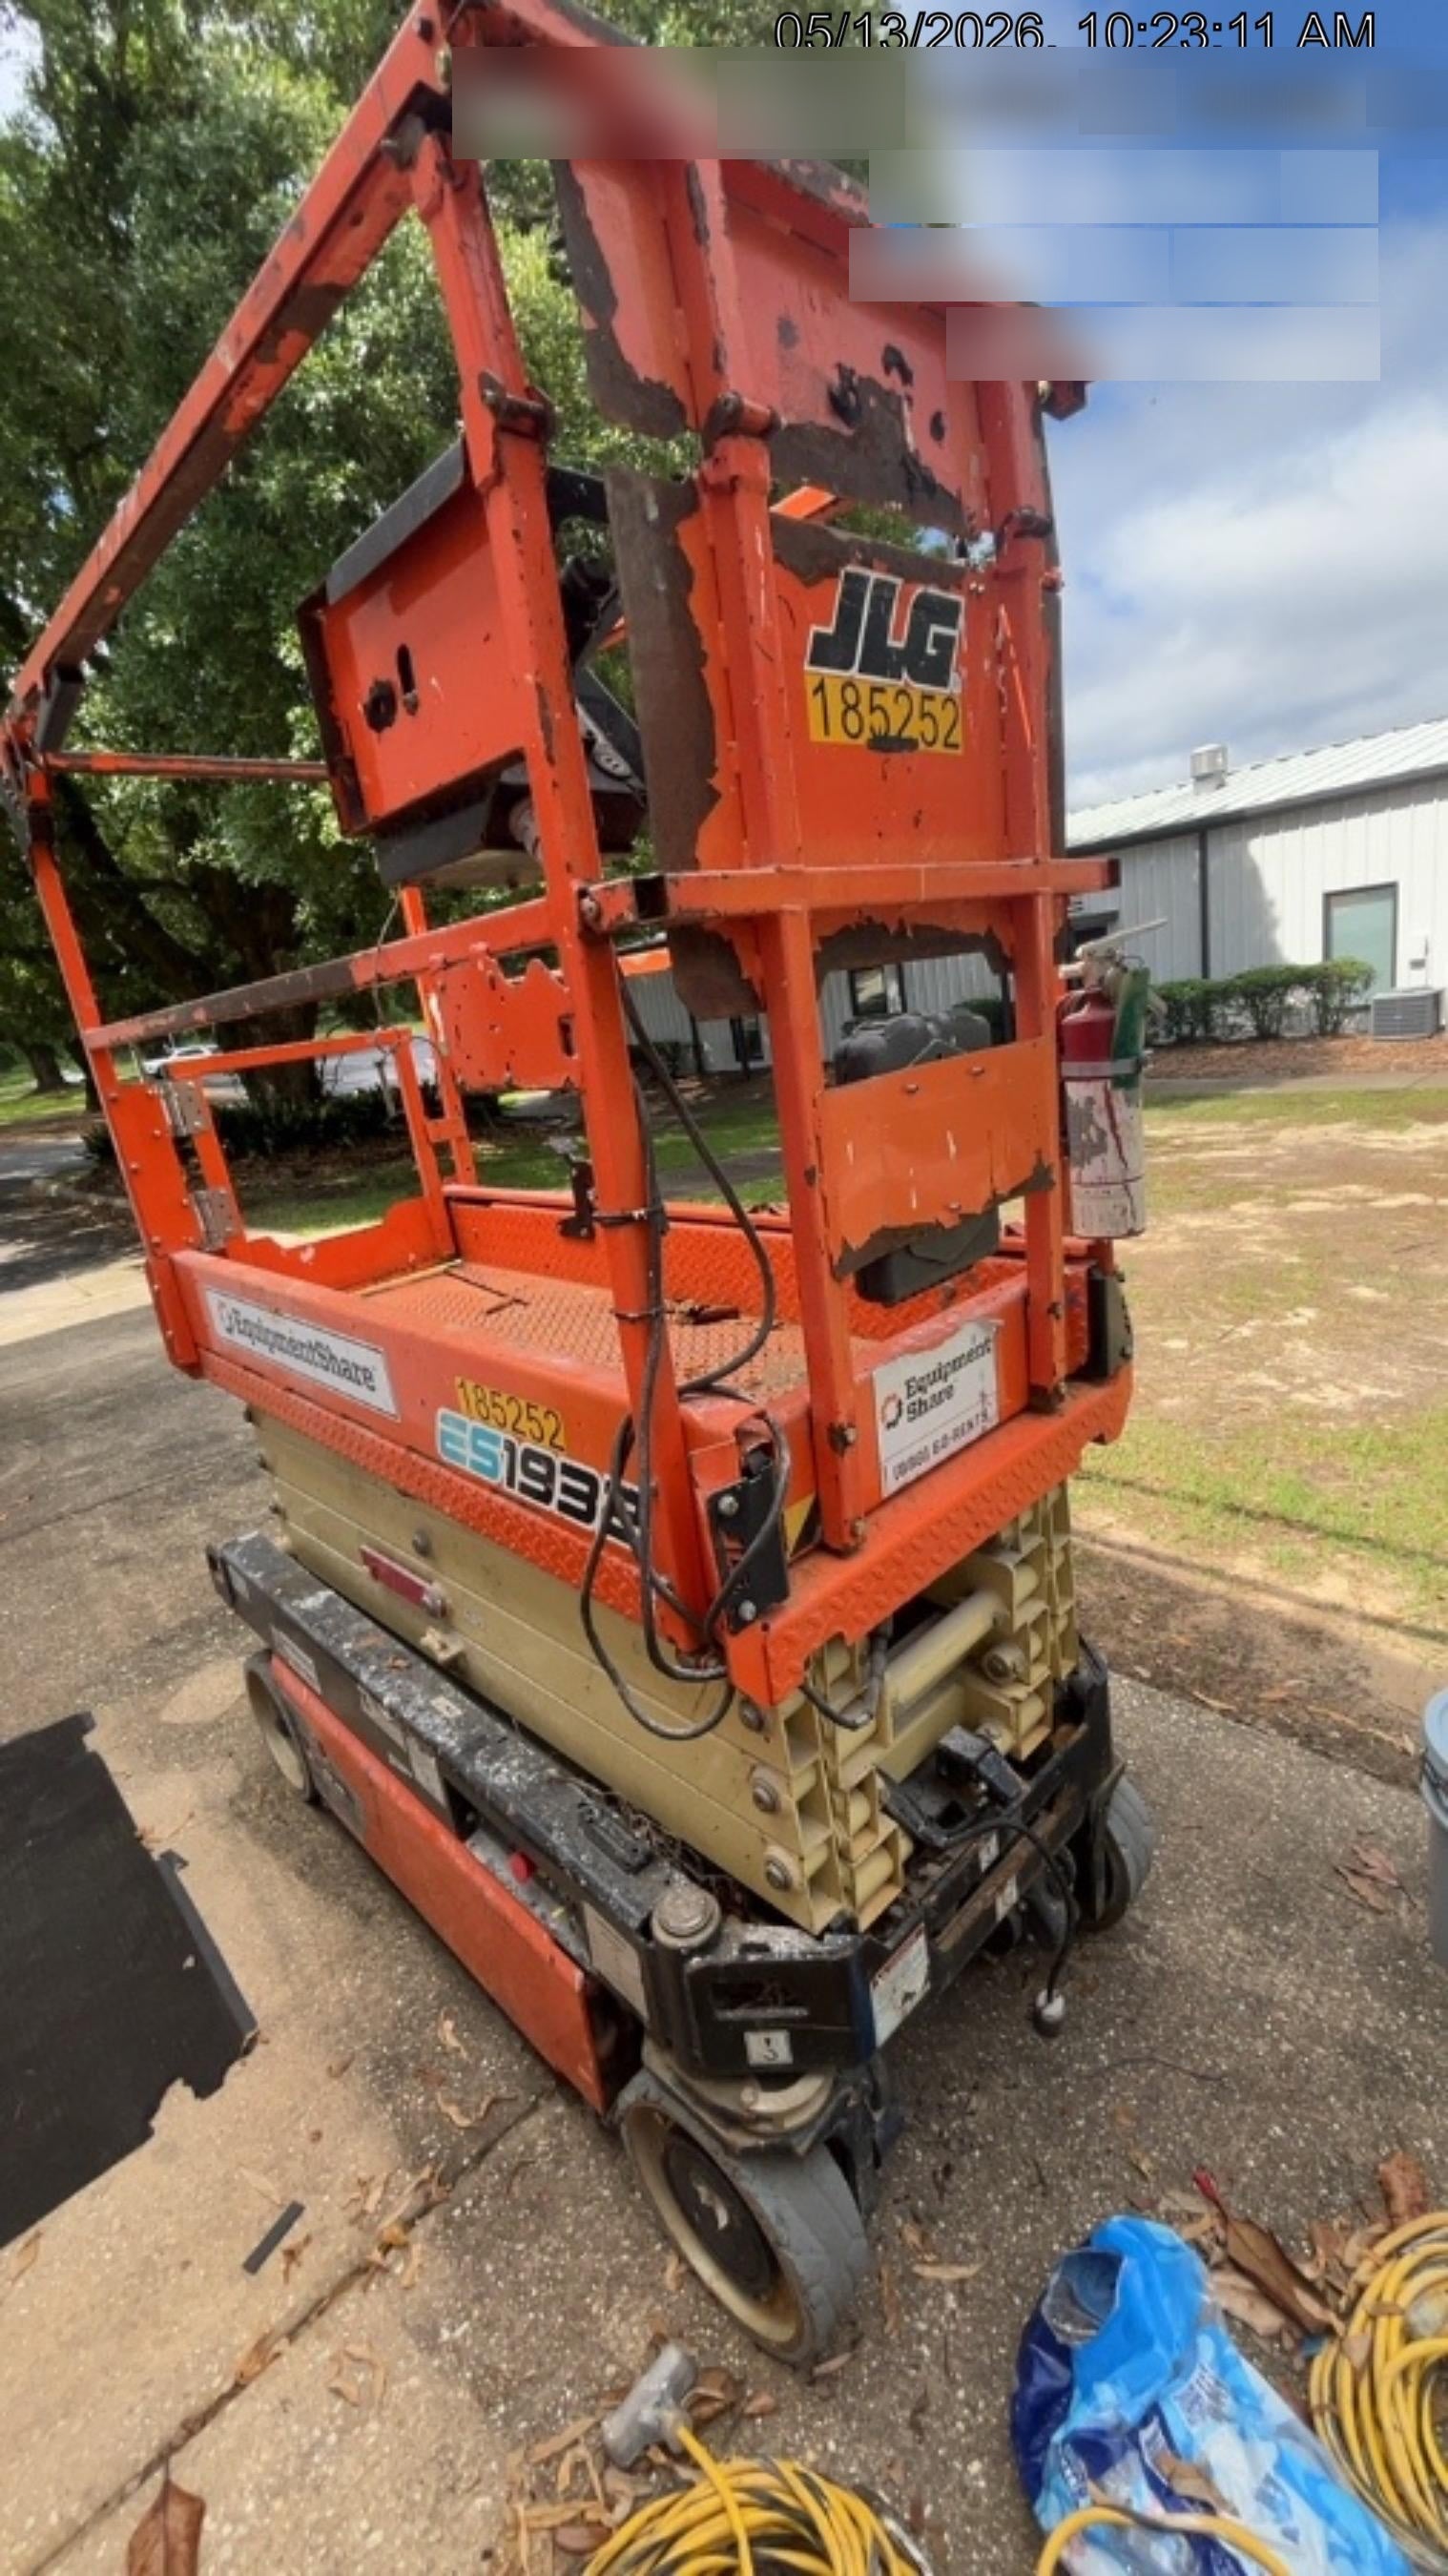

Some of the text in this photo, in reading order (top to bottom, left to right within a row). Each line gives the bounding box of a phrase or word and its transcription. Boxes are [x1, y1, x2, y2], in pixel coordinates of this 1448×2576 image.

[804, 565, 965, 695] JLG
[813, 675, 960, 750] 185252
[905, 1336, 992, 1399] Equipment
[907, 1383, 954, 1423] Share
[458, 1381, 565, 1452] 185252
